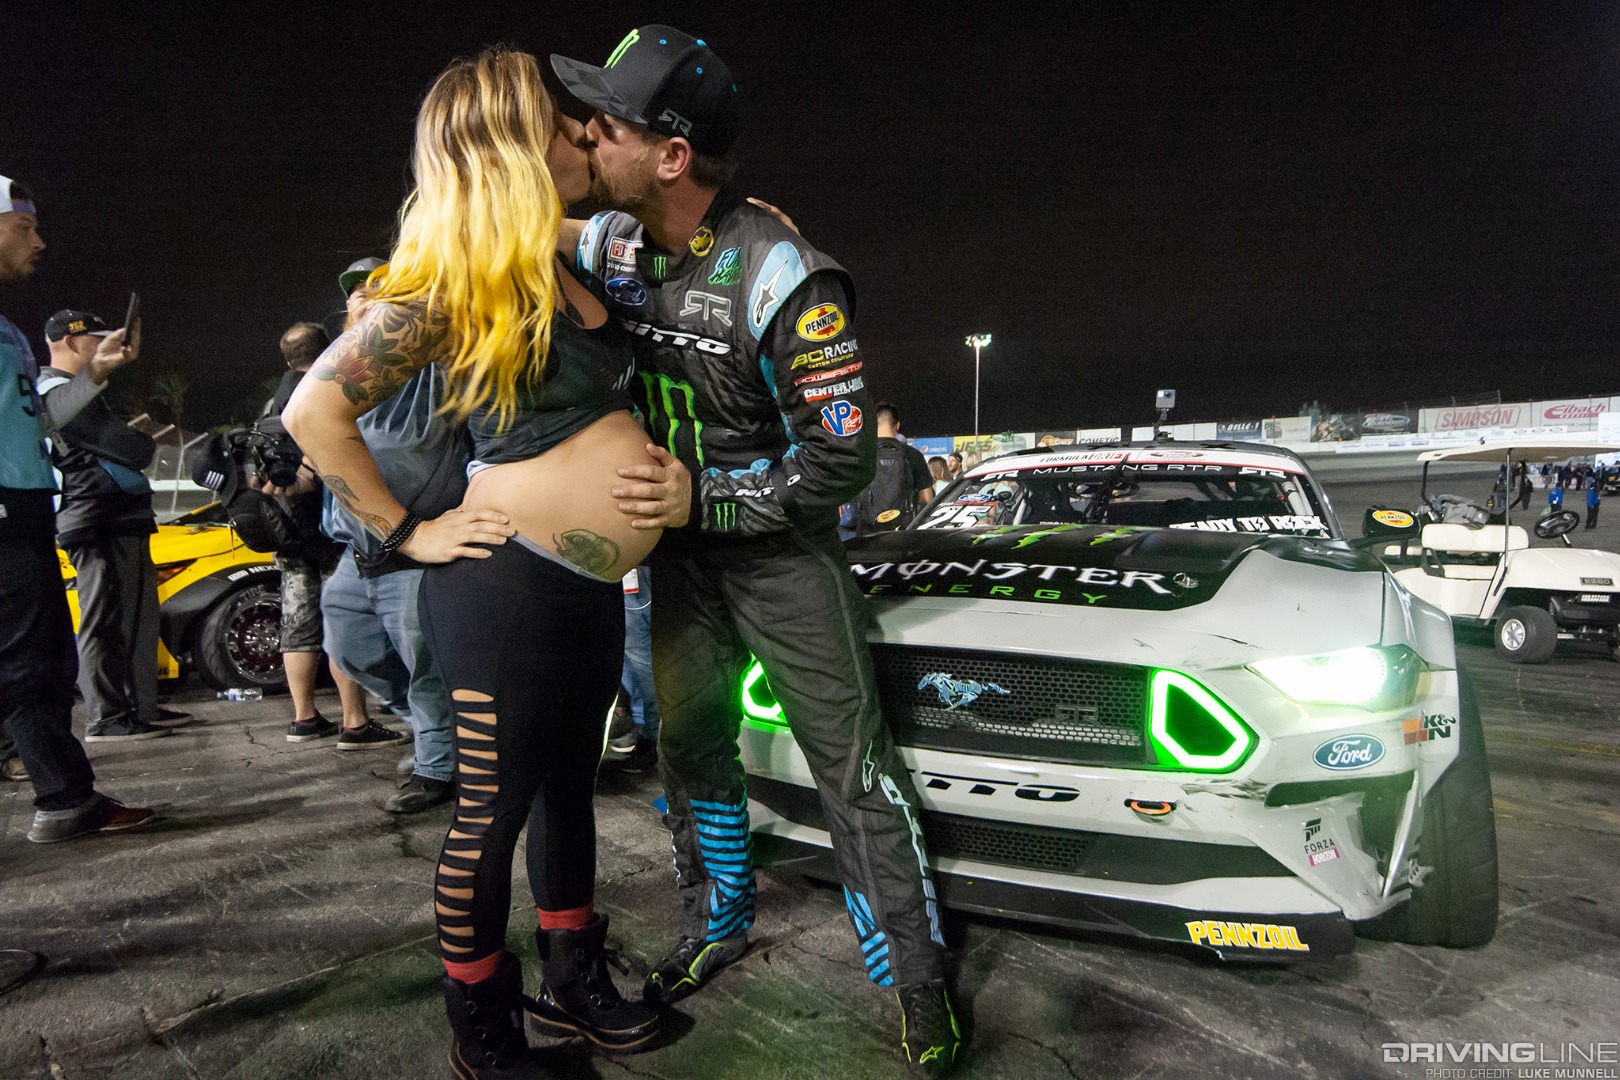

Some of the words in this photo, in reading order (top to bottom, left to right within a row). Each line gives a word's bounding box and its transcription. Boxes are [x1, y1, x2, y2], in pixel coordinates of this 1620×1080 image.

[680, 290, 733, 327] RTR
[805, 311, 839, 335] PENNZOIL
[821, 400, 852, 436] VP
[1441, 408, 1514, 428] SIMPSON
[1544, 403, 1606, 419] Eibach
[1033, 464, 1158, 475] MUSTANG
[1167, 464, 1223, 472] RTR
[917, 505, 992, 530] 25
[1169, 518, 1238, 532] READY
[870, 584, 1107, 604] ENERGY
[1328, 737, 1373, 765] Ford
[1304, 838, 1336, 854] FORZA
[1185, 920, 1309, 951] PENNZOIL
